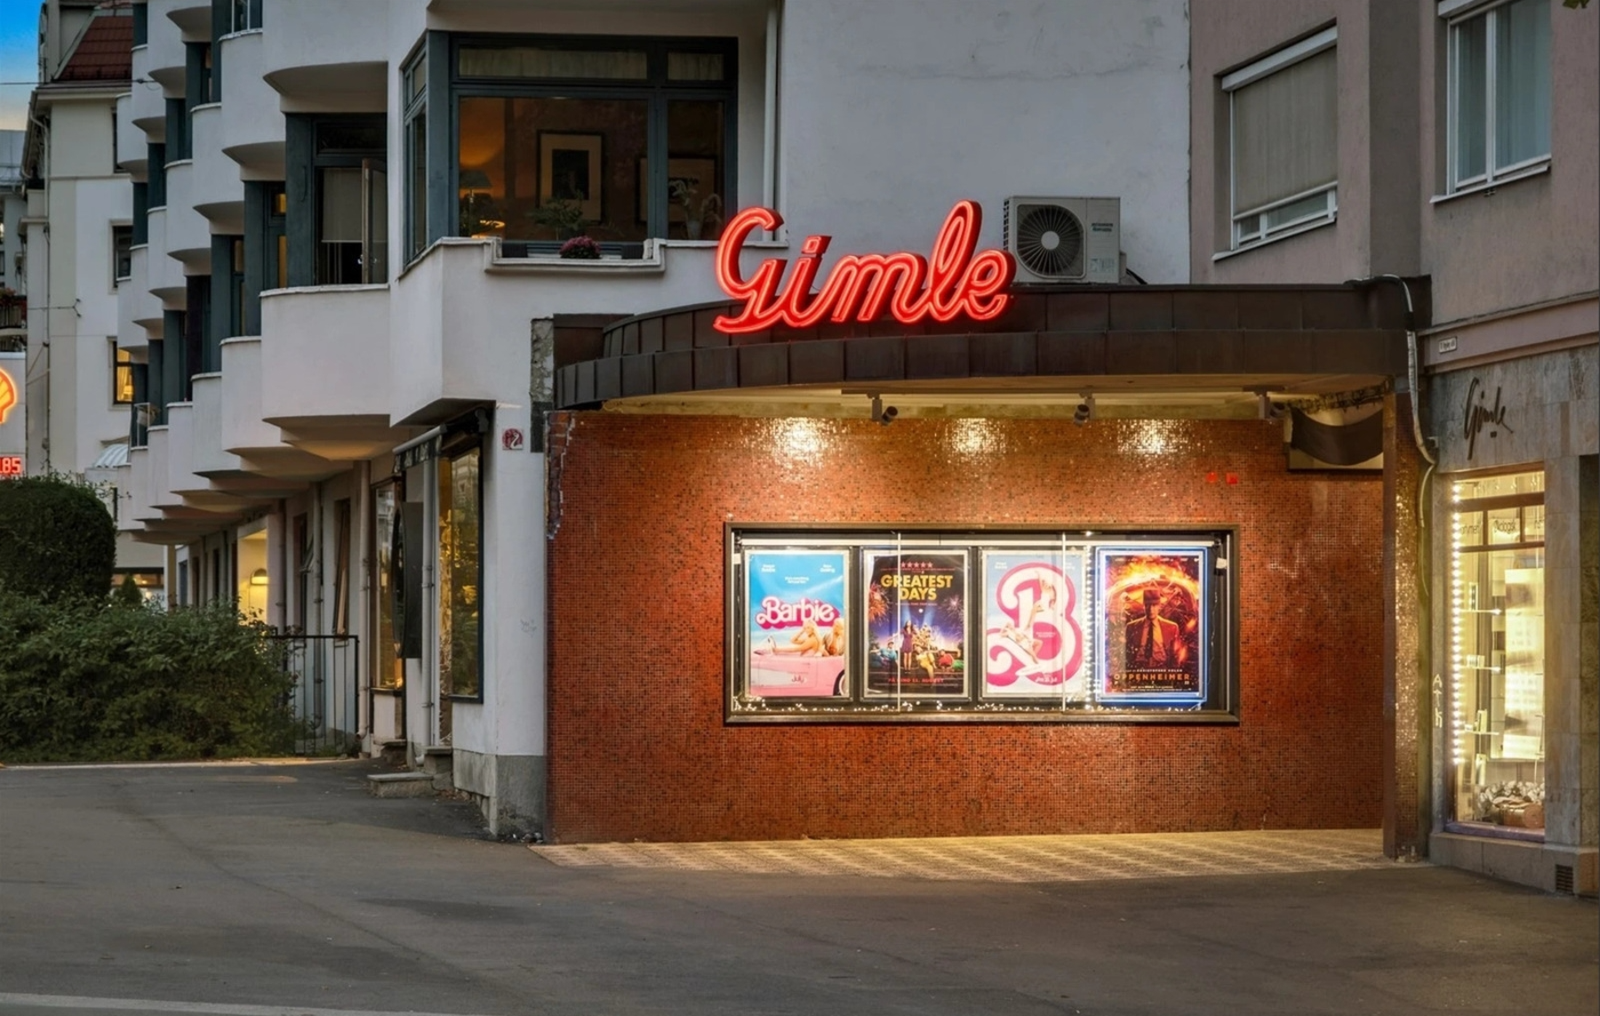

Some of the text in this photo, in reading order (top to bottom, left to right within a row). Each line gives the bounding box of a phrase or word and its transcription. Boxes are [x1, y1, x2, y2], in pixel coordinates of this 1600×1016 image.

[713, 199, 1016, 333] Gimle
[880, 574, 954, 588] GREATEST
[900, 587, 937, 601] DAYS
[755, 596, 838, 629] Barbie
[1113, 673, 1190, 681] OPPENHEIMER
